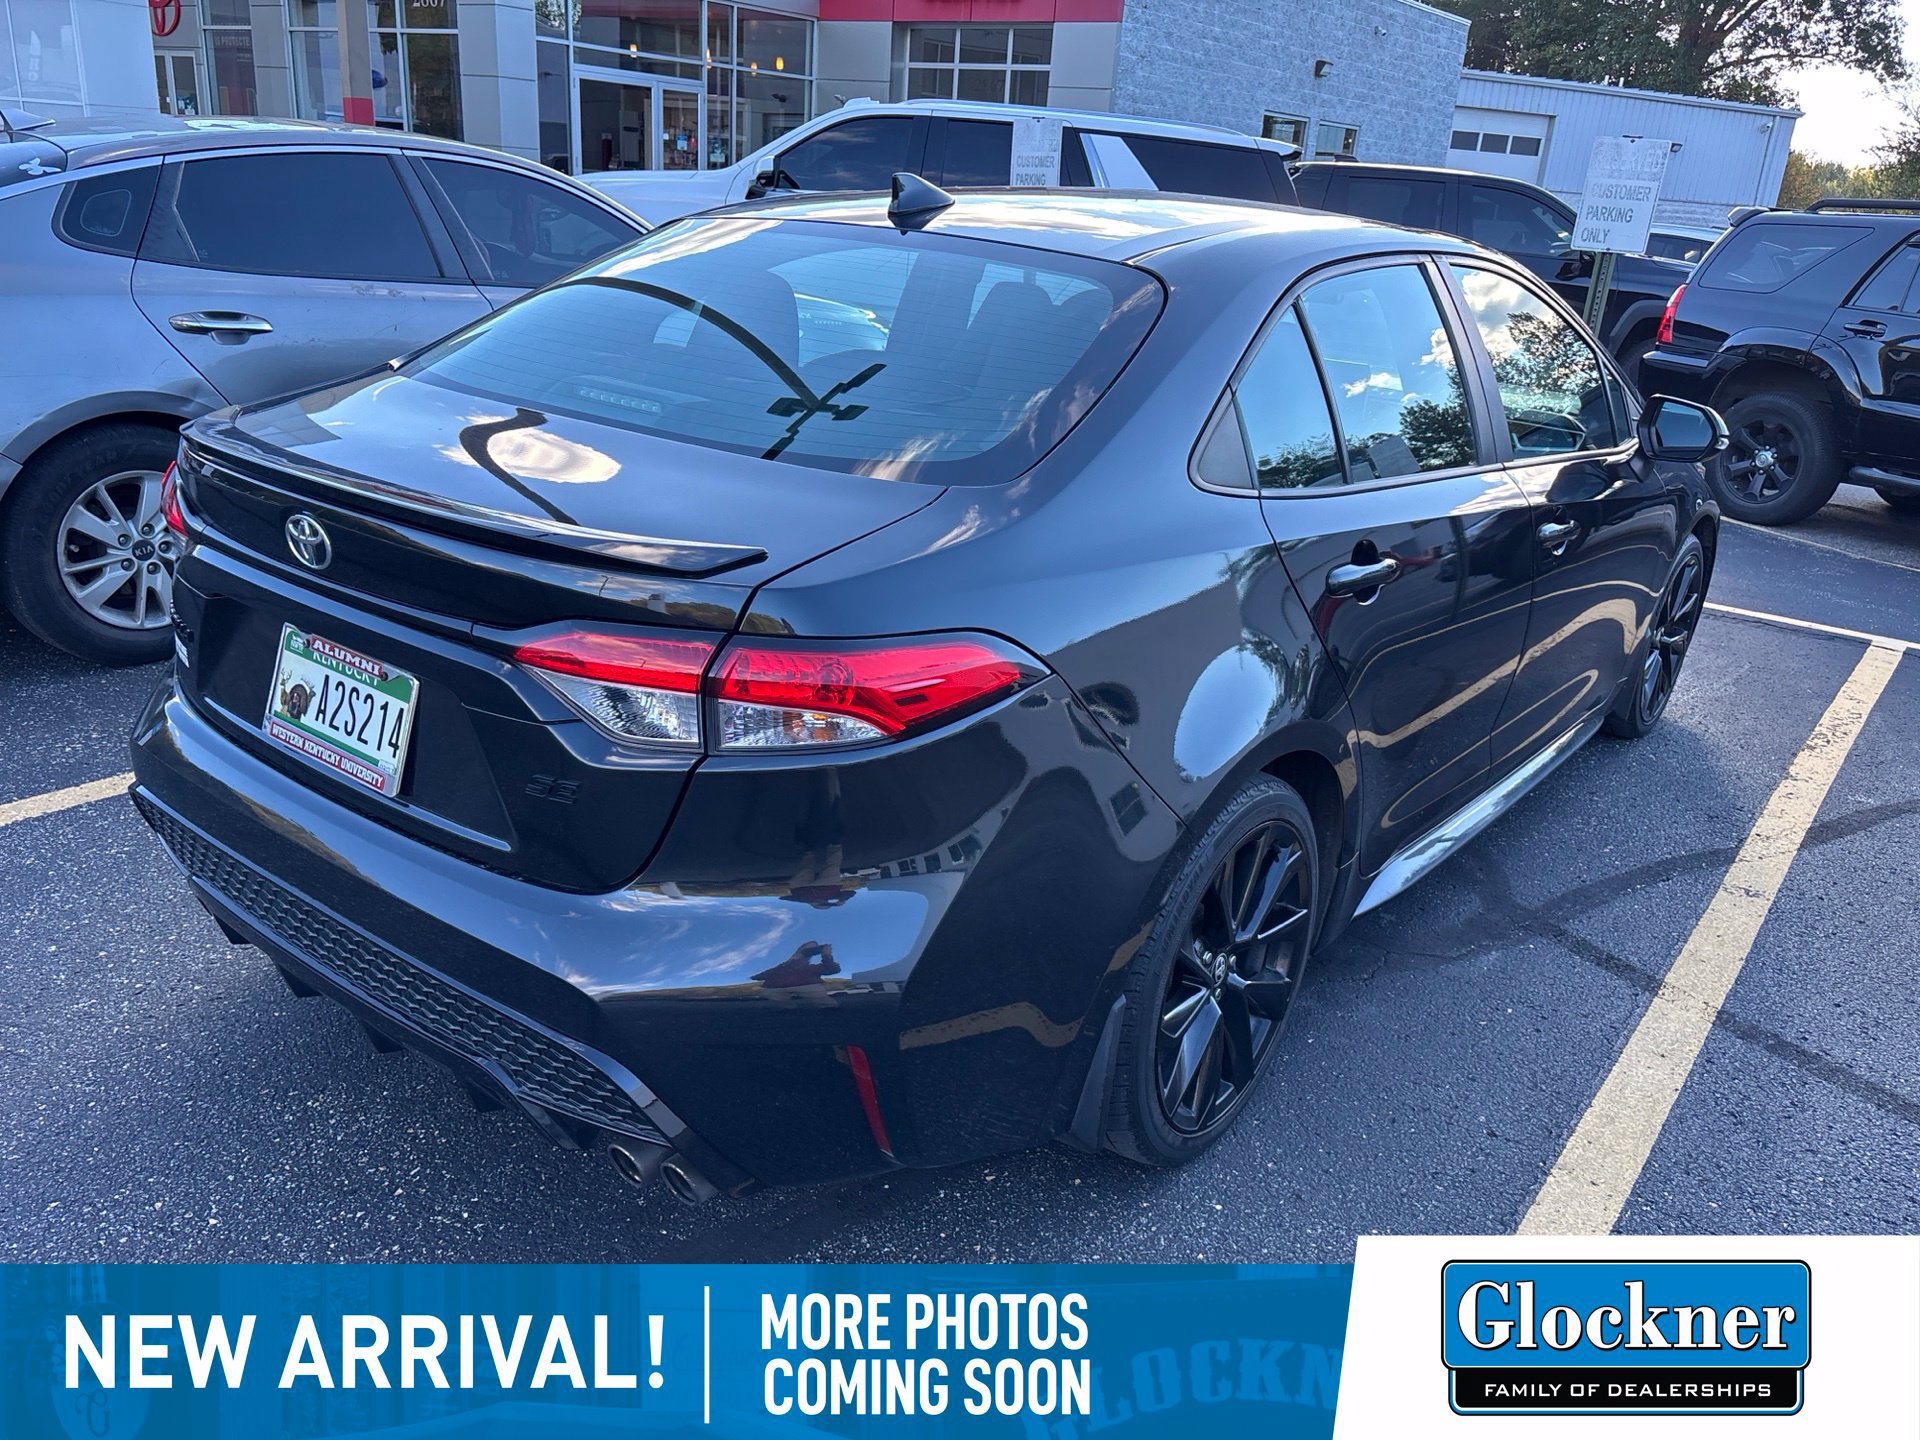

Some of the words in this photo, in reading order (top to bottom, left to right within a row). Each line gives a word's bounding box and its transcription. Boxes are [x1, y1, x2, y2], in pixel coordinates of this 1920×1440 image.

[1016, 155, 1055, 168] CUSTOMER
[1015, 173, 1046, 185] PARKING
[1591, 183, 1652, 202] CUSTOMER
[1585, 205, 1634, 223] PARKING
[1581, 227, 1610, 243] ONLY
[134, 545, 154, 557] KIA
[313, 639, 381, 676] ALUMNI
[315, 674, 405, 759] A2S214
[271, 722, 304, 747] WESTERN
[304, 740, 341, 766] KENTUCKY
[340, 757, 385, 788] UNIVERSITY
[525, 774, 580, 804] SE
